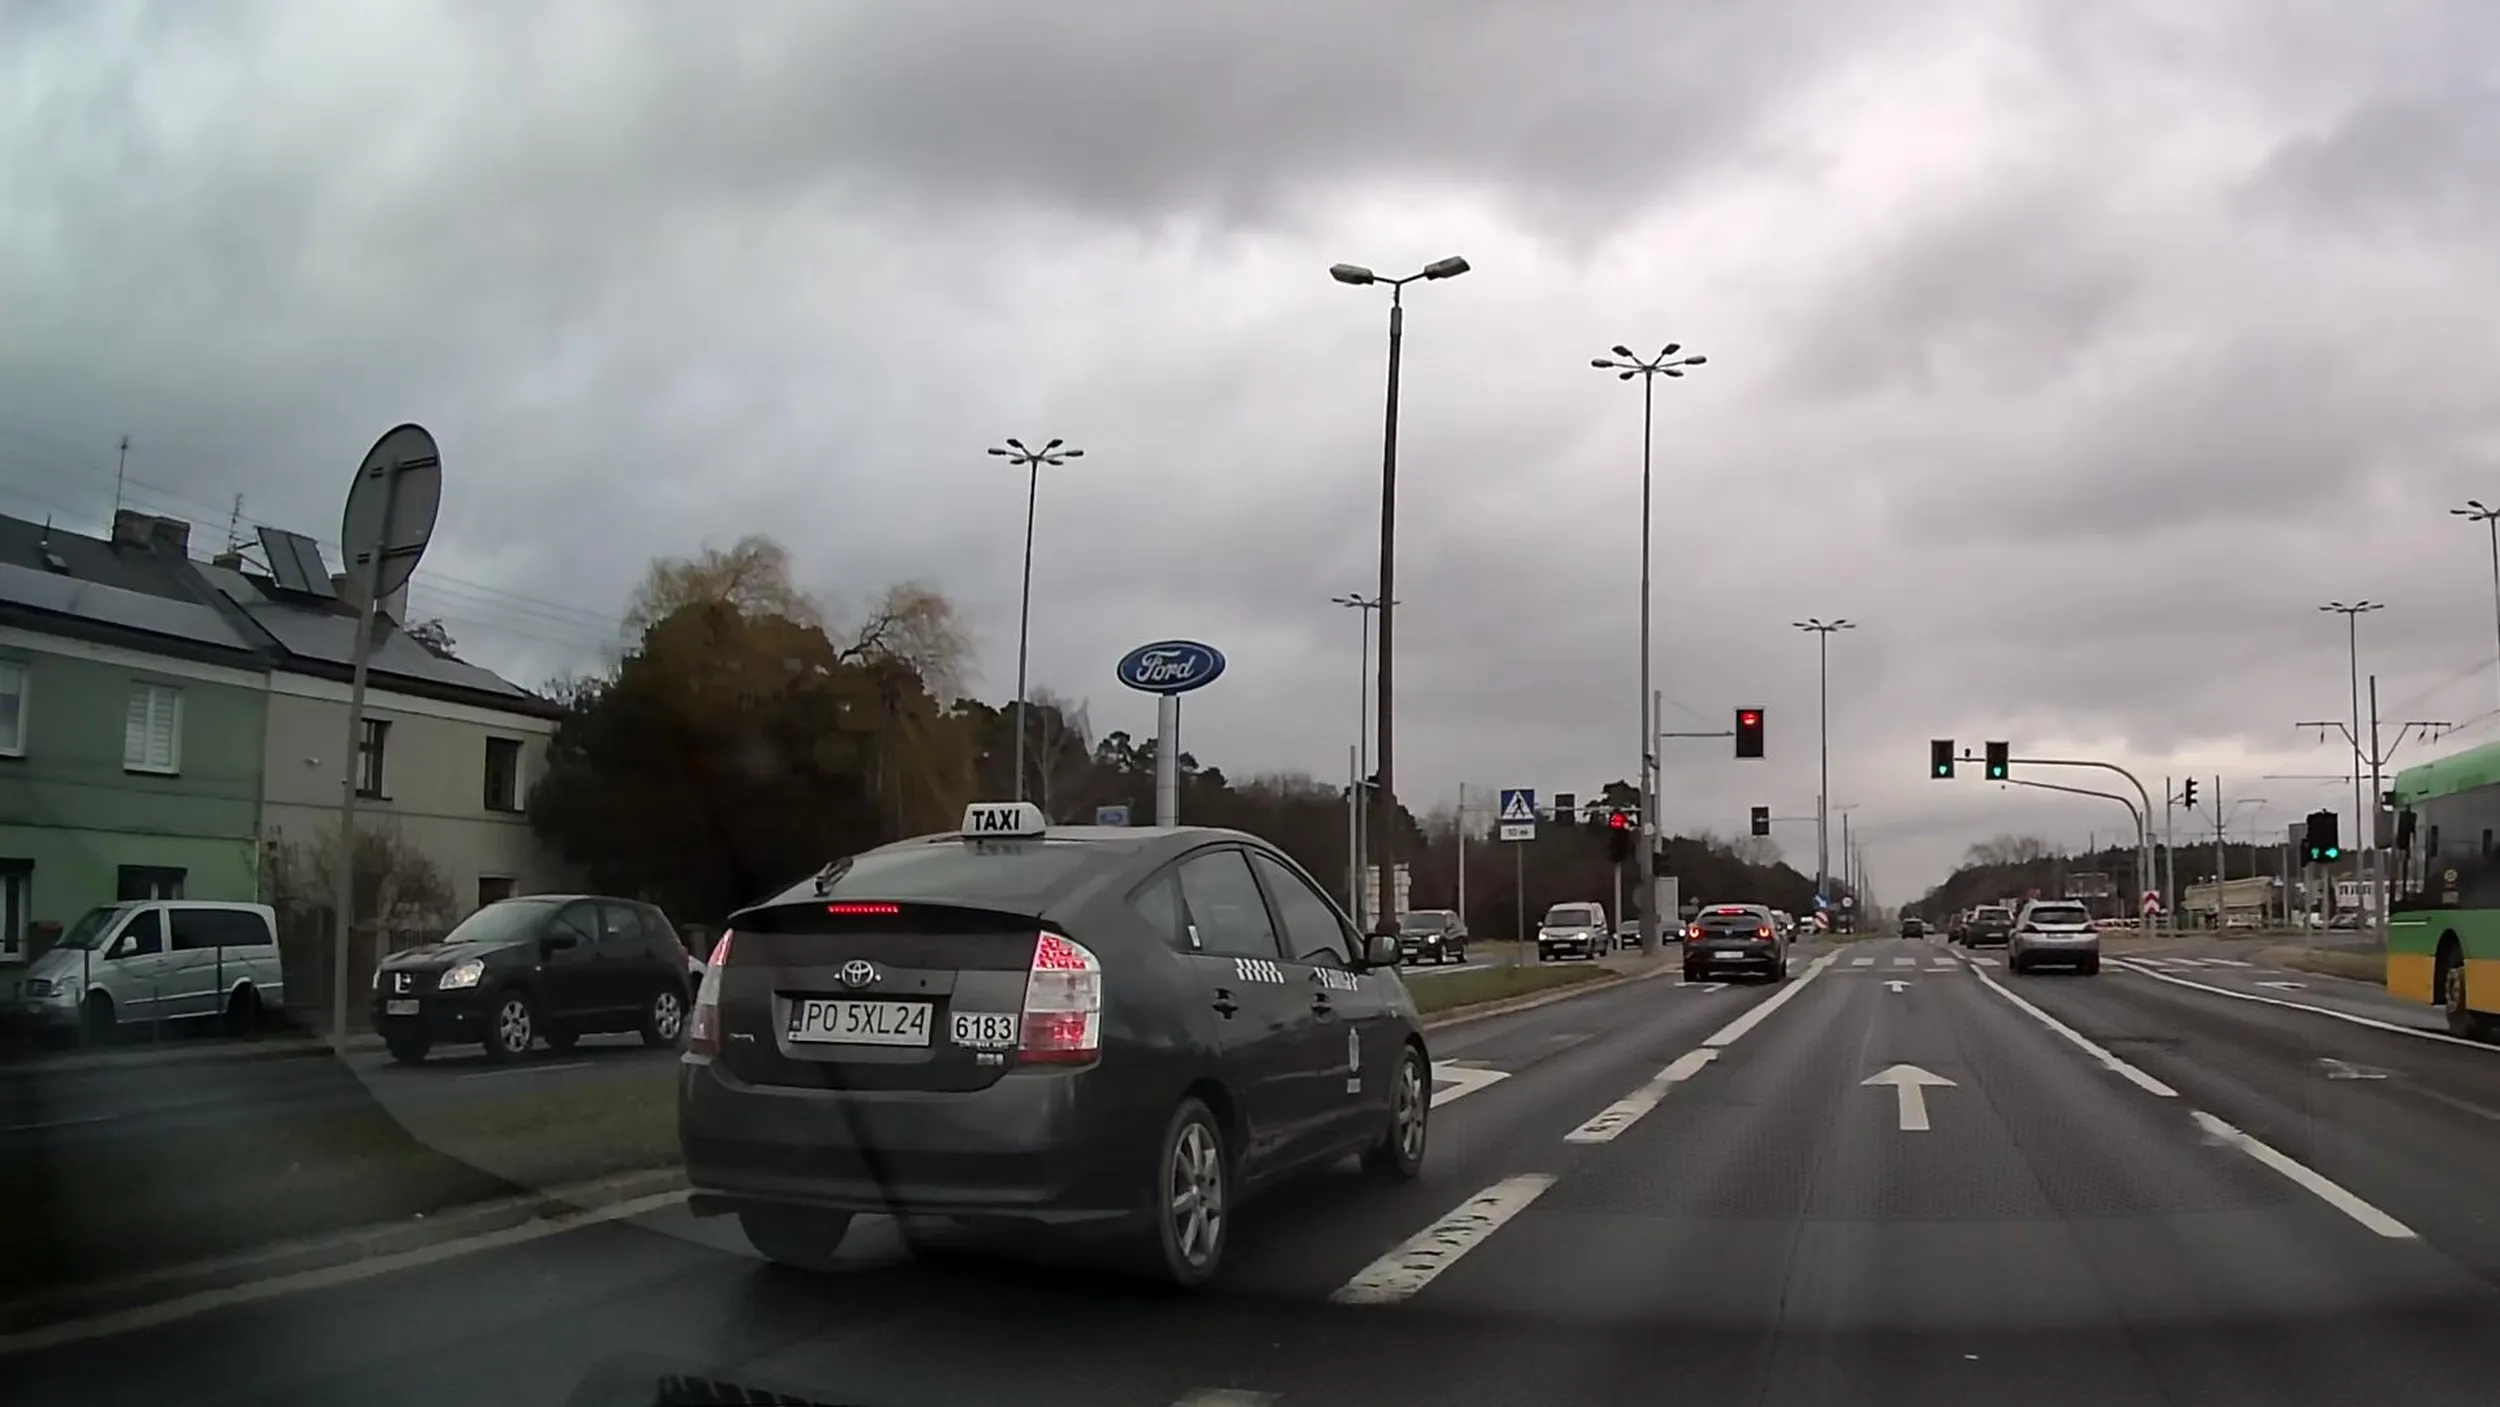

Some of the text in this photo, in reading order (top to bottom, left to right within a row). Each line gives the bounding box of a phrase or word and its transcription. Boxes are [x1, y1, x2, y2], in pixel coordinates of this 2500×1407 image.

[1136, 650, 1195, 682] Ford
[972, 810, 1020, 831] TAXI
[846, 1004, 927, 1036] 5XL24
[955, 1015, 1012, 1040] 6183
